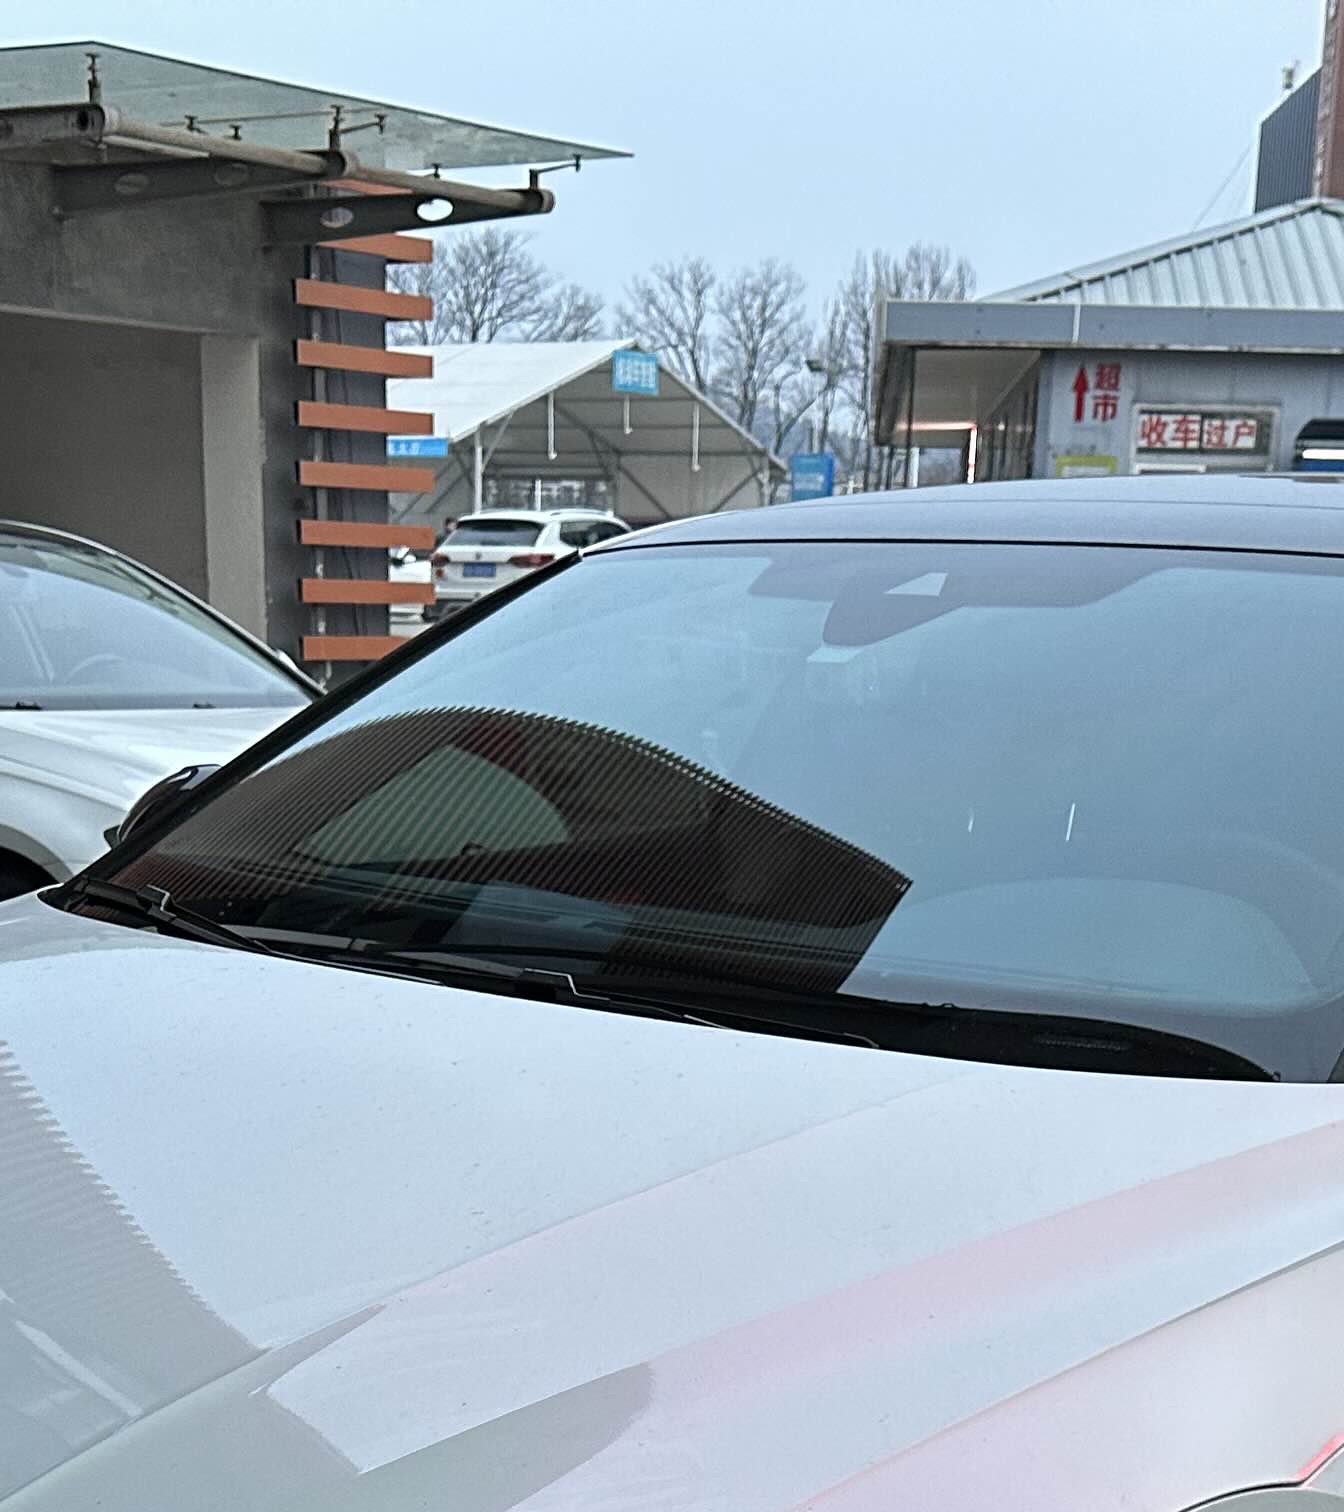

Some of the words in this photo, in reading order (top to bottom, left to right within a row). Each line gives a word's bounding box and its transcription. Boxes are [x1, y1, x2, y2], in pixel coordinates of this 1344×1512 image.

[1092, 362, 1120, 421] 超市
[1140, 413, 1256, 448] 收车过户
